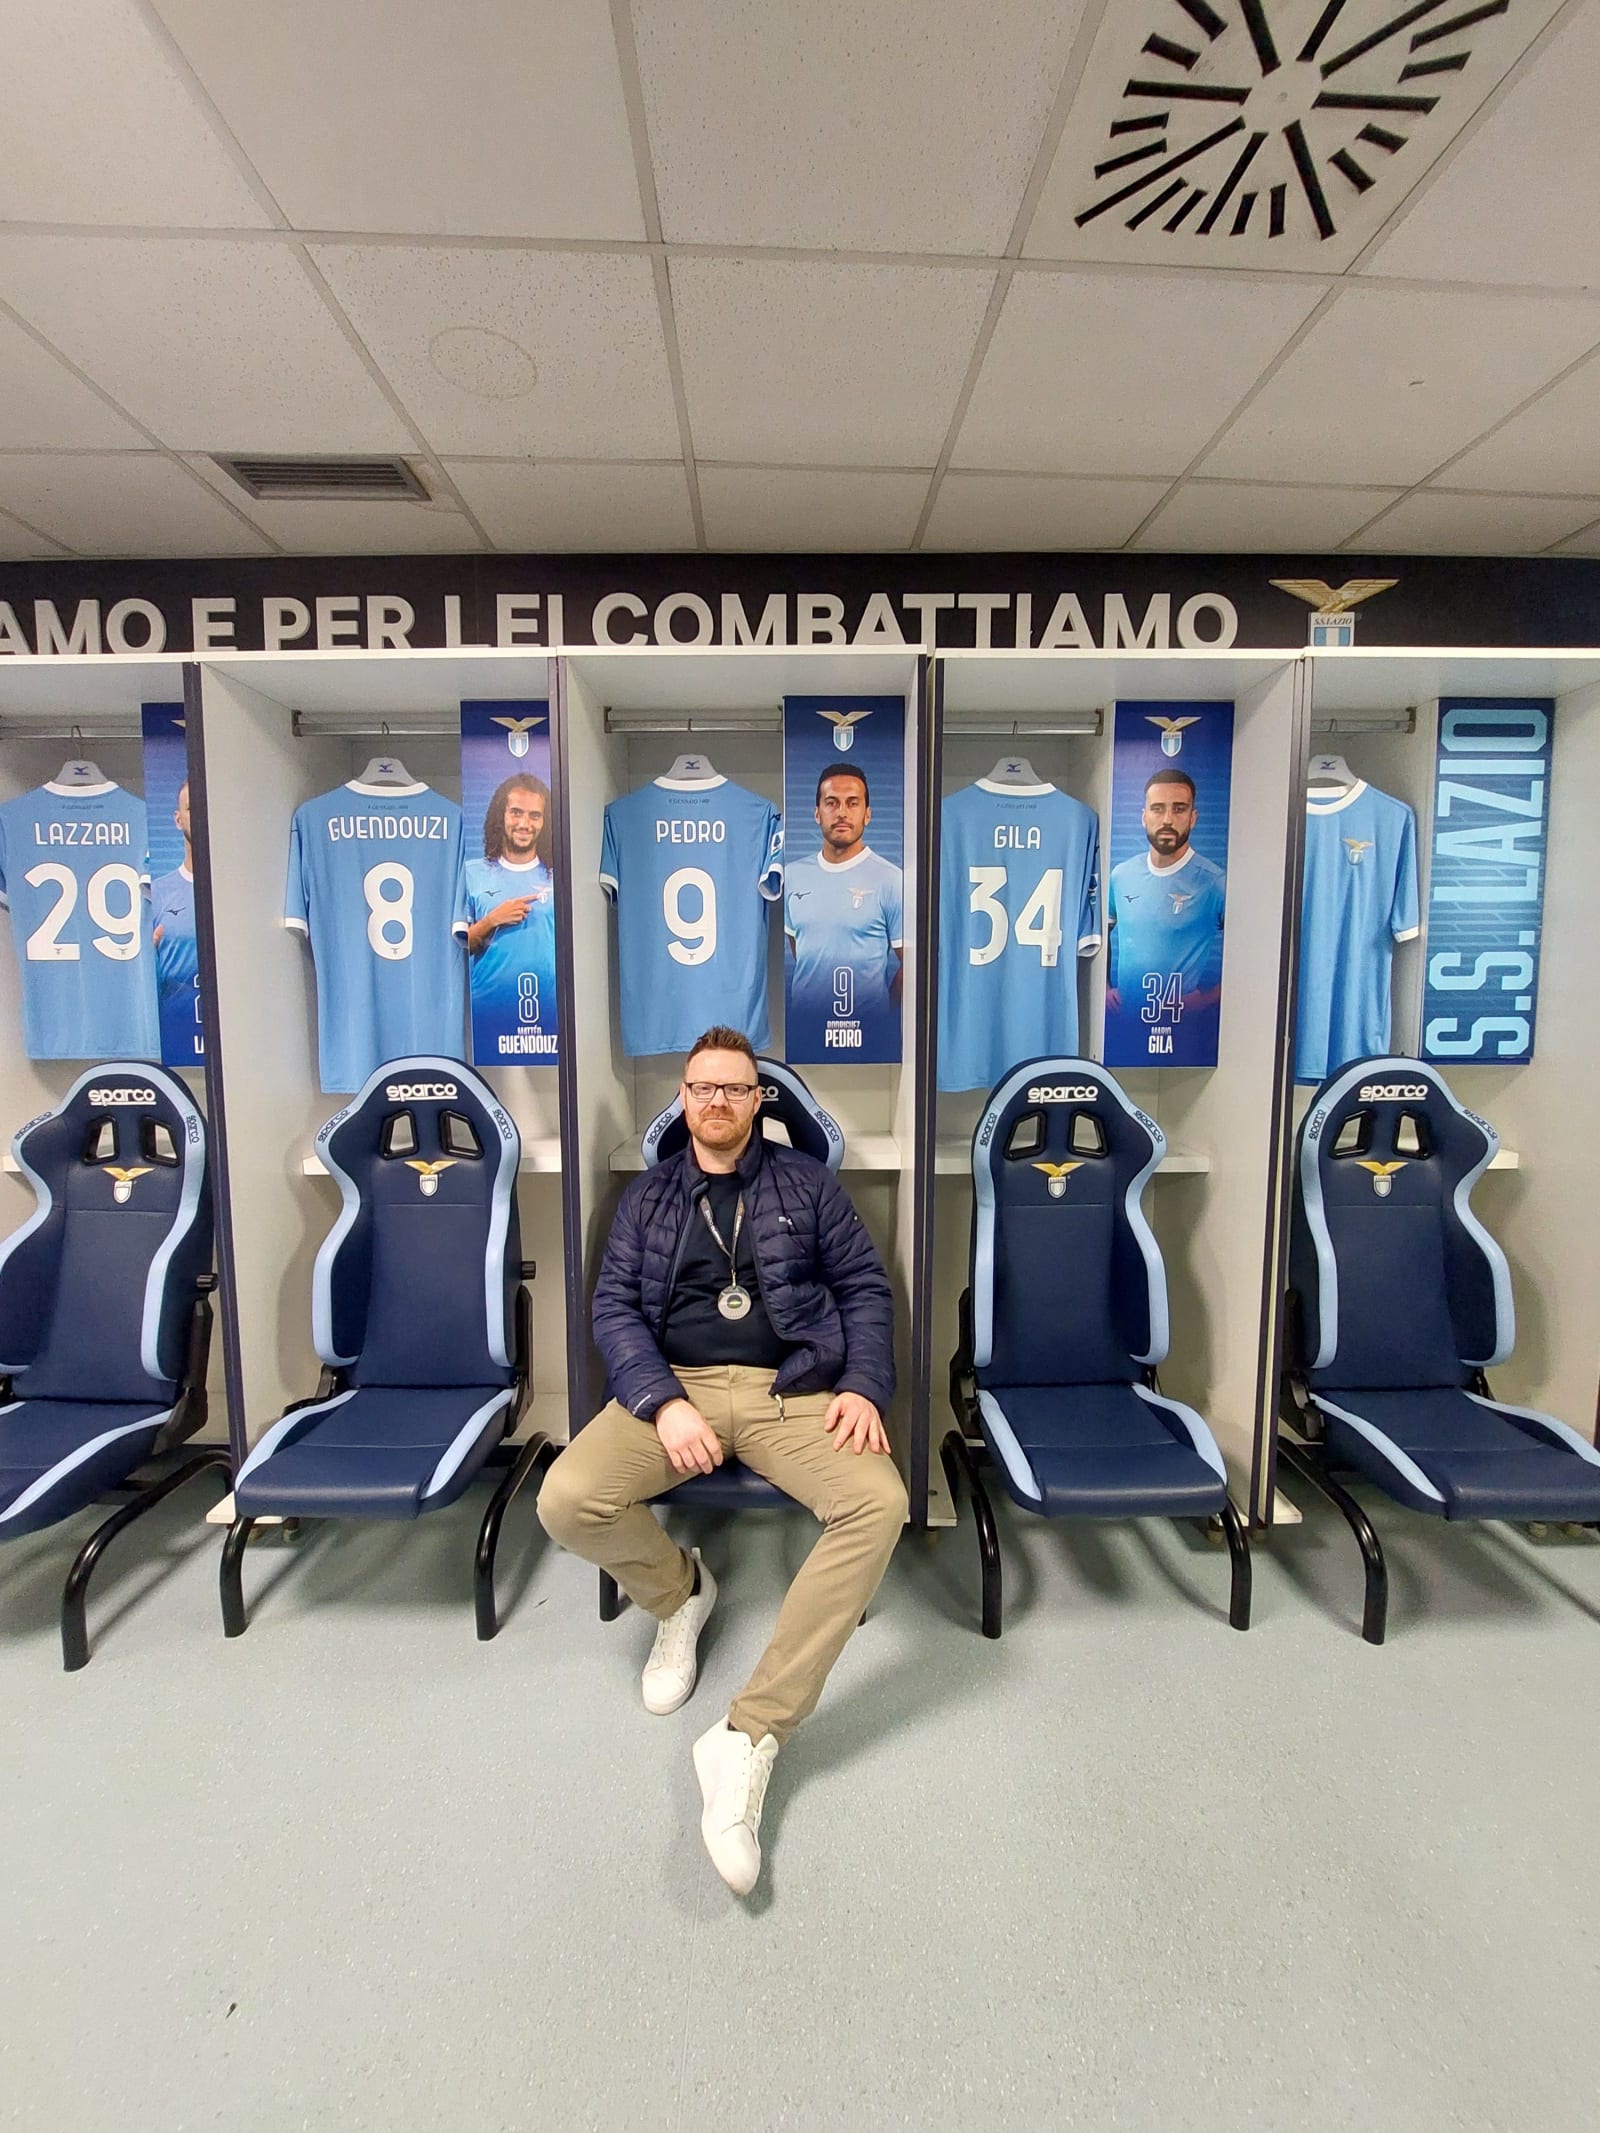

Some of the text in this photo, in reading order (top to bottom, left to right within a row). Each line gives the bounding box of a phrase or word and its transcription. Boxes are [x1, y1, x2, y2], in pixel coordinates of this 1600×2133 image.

[191, 597, 237, 651] E
[262, 595, 415, 650] PER
[444, 594, 564, 648] LEI
[591, 592, 1239, 649] COMBATTIAMO
[1433, 709, 1548, 901] LAZIO
[34, 822, 130, 845] LAZZARI
[328, 816, 448, 842] GUENDOUZI
[655, 820, 726, 843] PEDRO
[994, 825, 1041, 850] GILA
[24, 862, 142, 961] 29
[363, 861, 414, 961] 8
[663, 867, 717, 966] 9
[968, 866, 1064, 967] 34
[517, 972, 539, 1023] 8
[833, 966, 854, 1017] 9
[1141, 972, 1184, 1023] 34
[498, 1034, 558, 1054] GUENDOUZ
[825, 1029, 862, 1048] PEDRO
[1148, 1035, 1173, 1054] GILA
[88, 1088, 157, 1107] sparco
[385, 1083, 458, 1102] sparco
[1027, 1085, 1099, 1104] sparco
[1358, 1084, 1429, 1103] sparco
[186, 1115, 200, 1144] sparco
[317, 1109, 350, 1143] sparco
[492, 1108, 513, 1141] sparco
[647, 1112, 674, 1146] sparco
[814, 1110, 840, 1143] sparco
[980, 1112, 998, 1147] sparco
[1133, 1110, 1164, 1143] sparco
[1308, 1109, 1327, 1142] sparco
